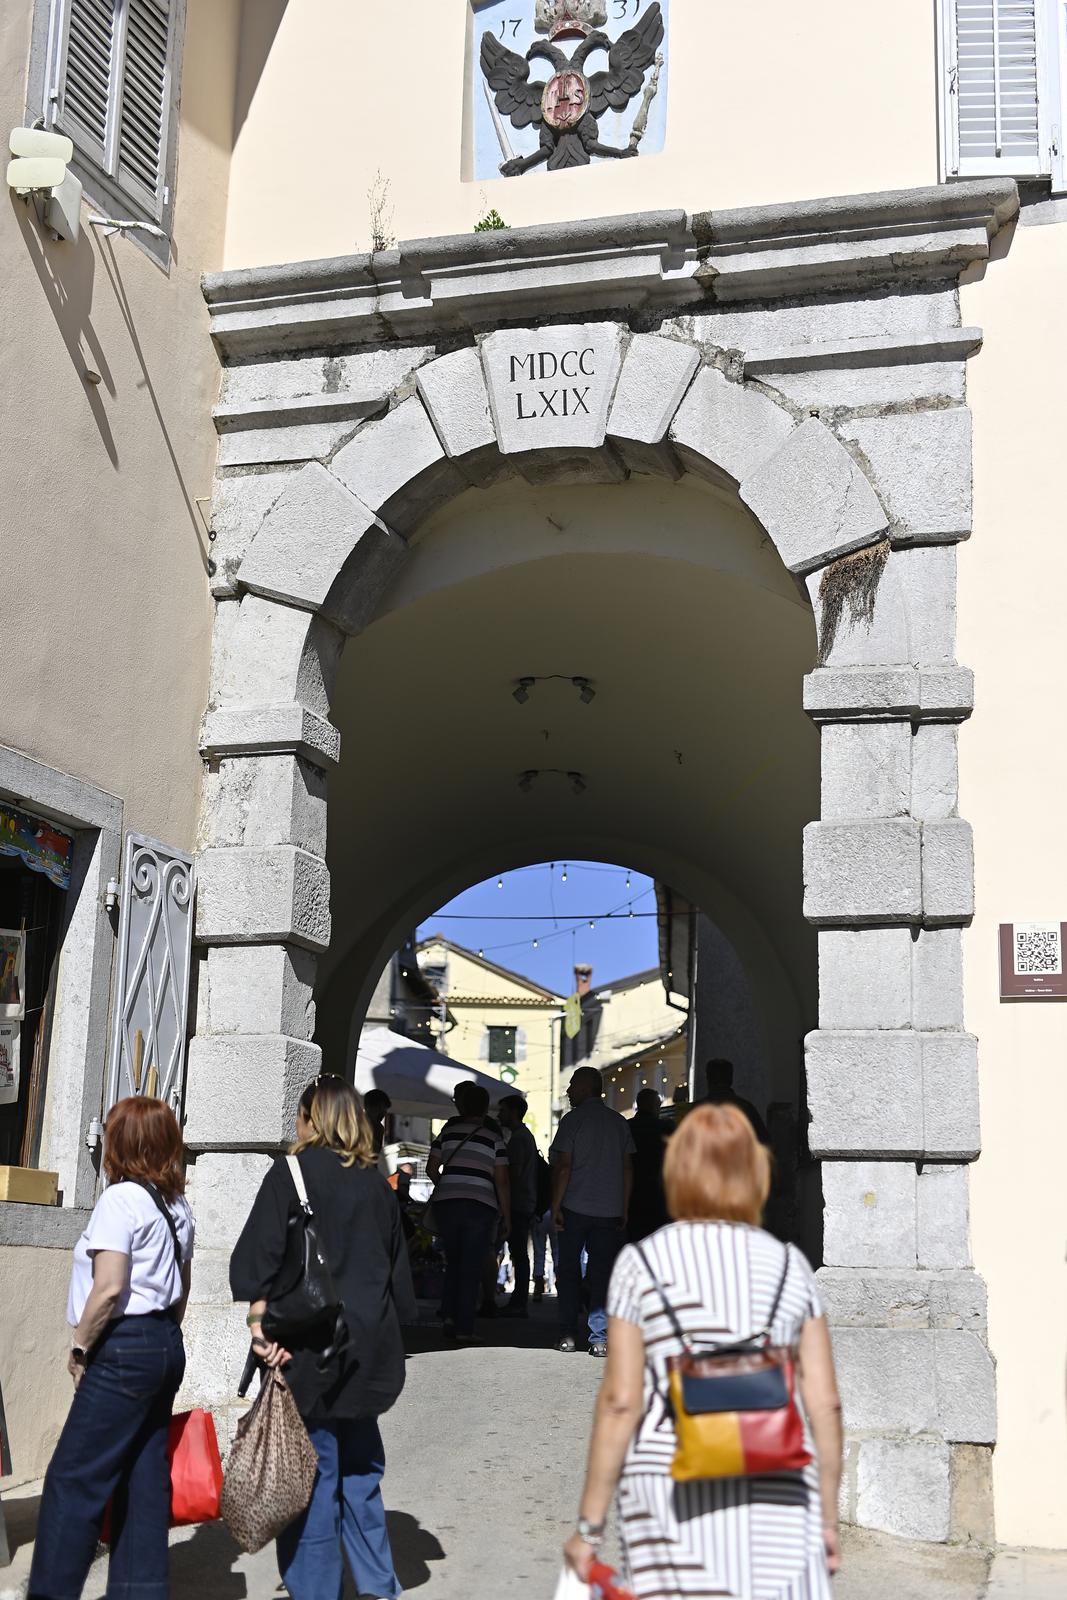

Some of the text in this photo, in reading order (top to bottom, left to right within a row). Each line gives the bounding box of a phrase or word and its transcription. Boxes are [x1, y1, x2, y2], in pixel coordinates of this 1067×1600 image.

[499, 19, 522, 40] 17
[509, 348, 595, 383] MDCC
[515, 386, 591, 420] LXIX
